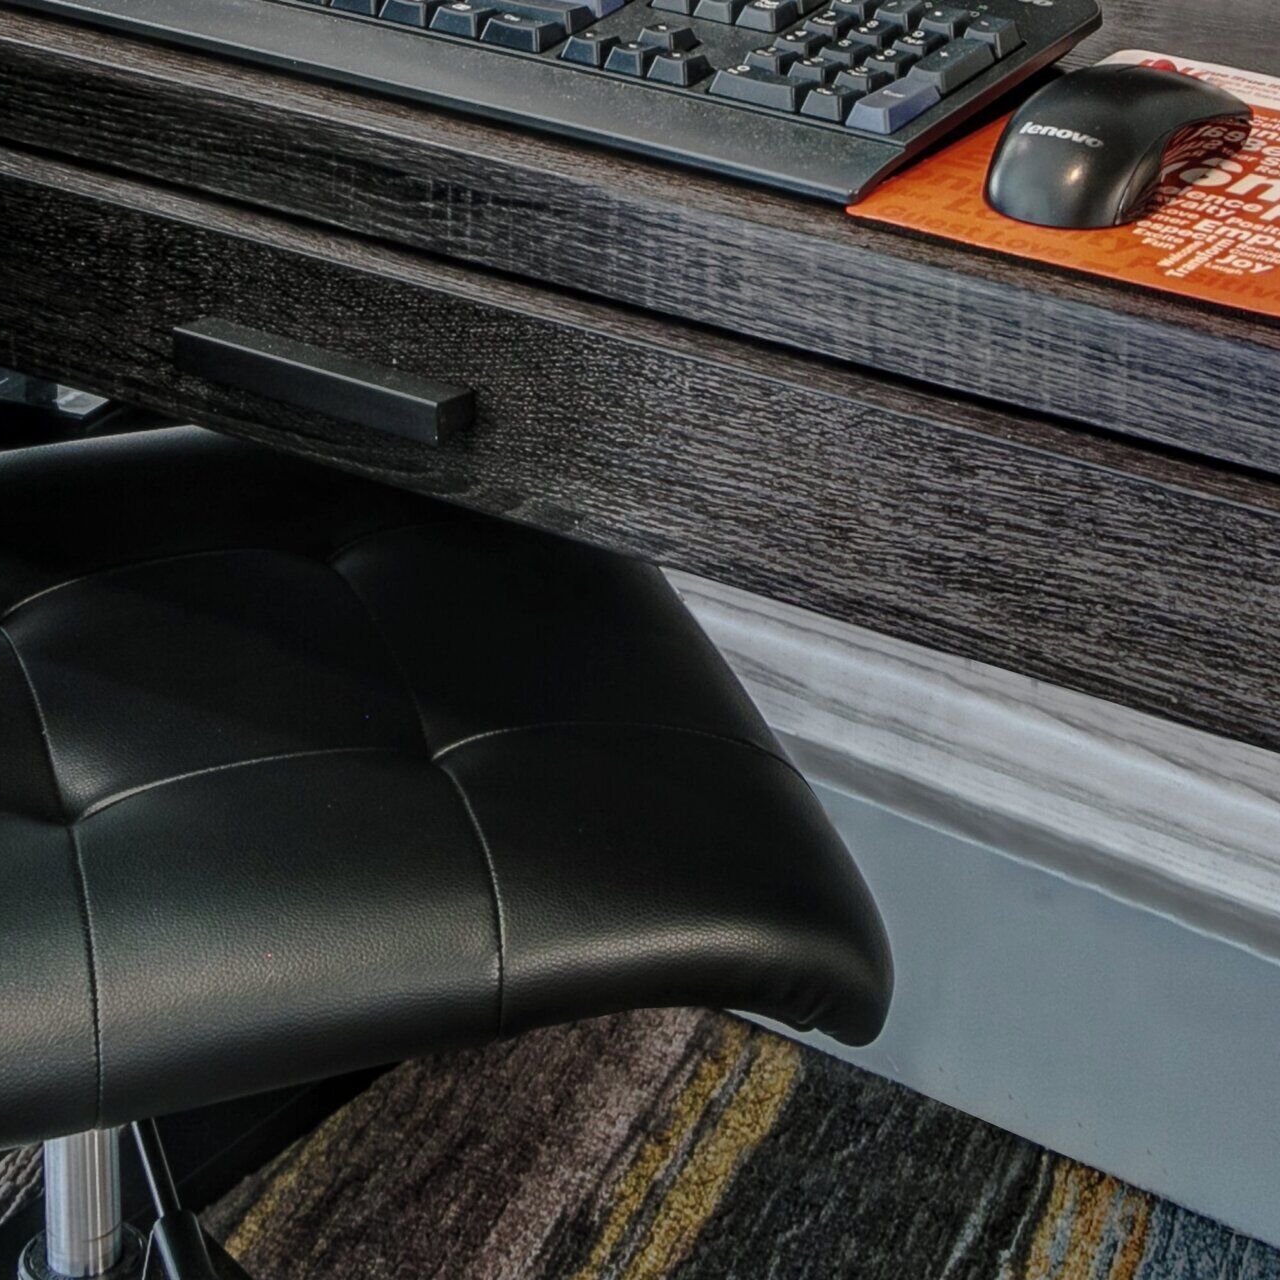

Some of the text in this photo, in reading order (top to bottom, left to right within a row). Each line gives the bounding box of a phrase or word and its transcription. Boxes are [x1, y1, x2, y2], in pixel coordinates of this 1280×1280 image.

[1019, 121, 1103, 148] lenovo
[1137, 220, 1218, 243] espect
[1142, 237, 1177, 250] Fun
[1216, 254, 1274, 274] Joy
